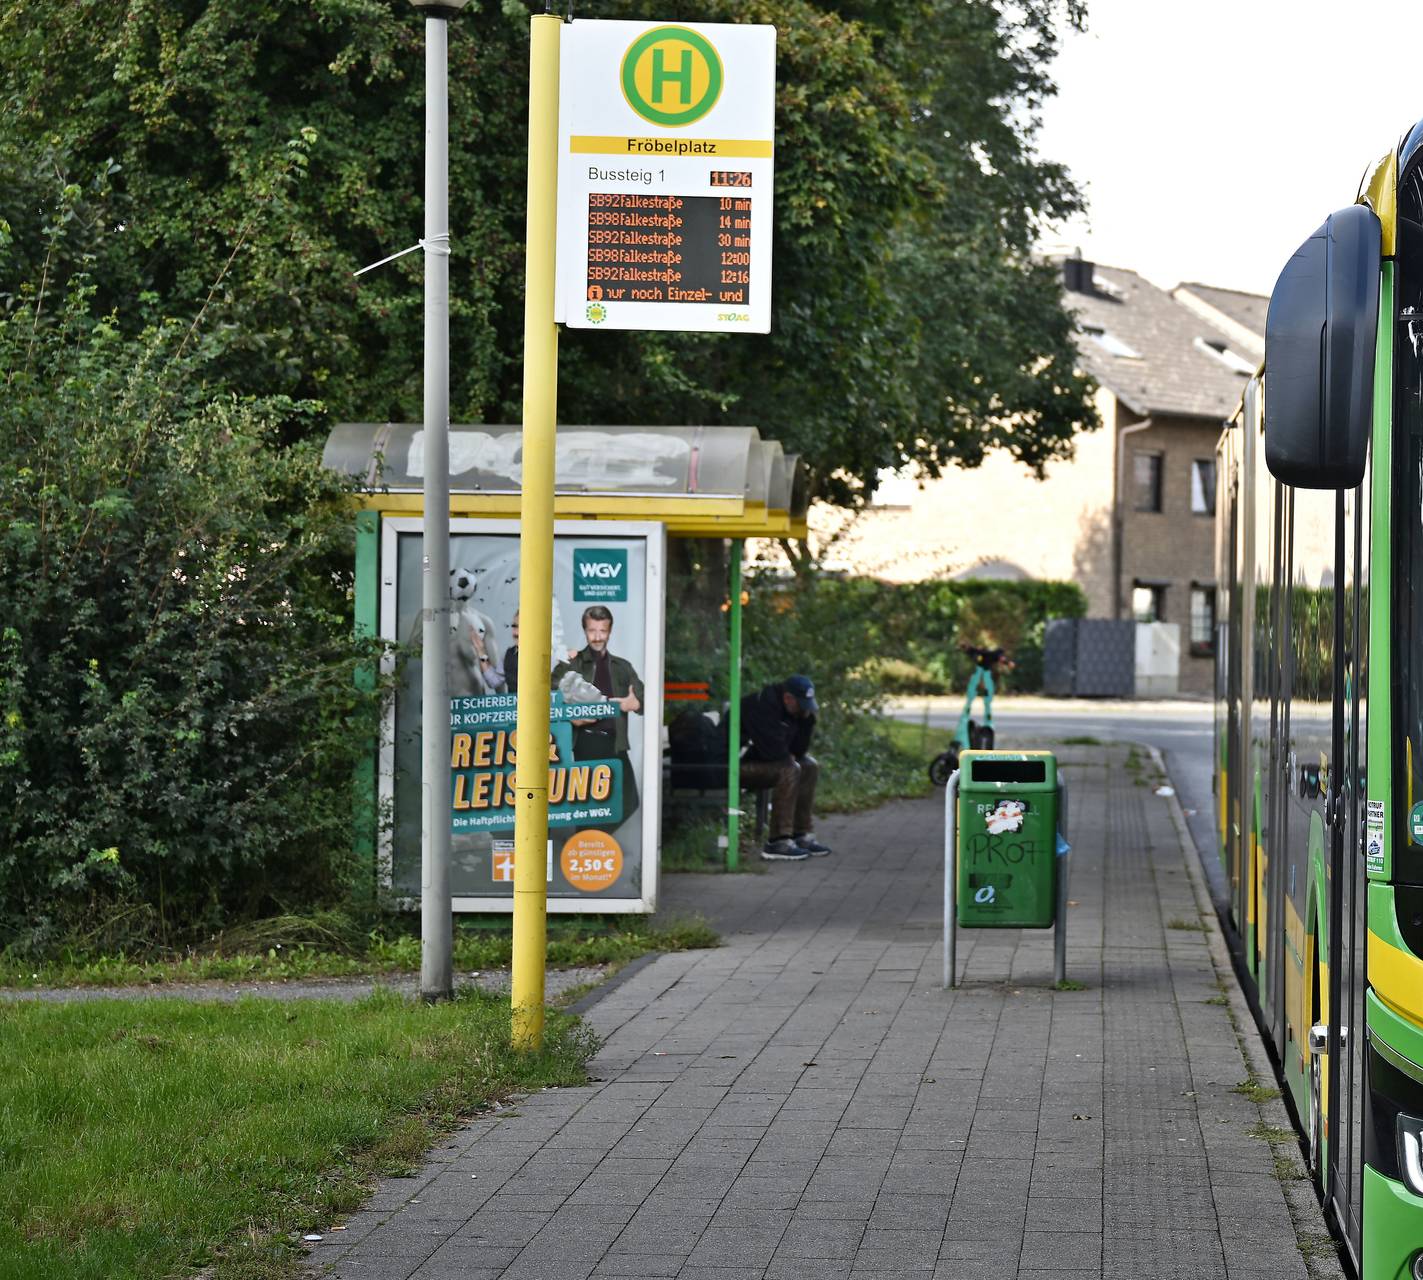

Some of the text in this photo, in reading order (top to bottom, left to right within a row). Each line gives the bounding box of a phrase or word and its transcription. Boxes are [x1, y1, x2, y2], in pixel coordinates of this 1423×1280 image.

[652, 48, 692, 104] H
[627, 138, 716, 156] Fröbelplatz
[589, 167, 665, 184] Bussteig 1
[712, 172, 751, 186] 11:26
[720, 198, 731, 210] 10
[720, 216, 731, 228] 14
[718, 233, 731, 247] 30
[721, 253, 750, 265] 12:00
[721, 271, 749, 284] 12:16
[632, 288, 663, 299] noch
[668, 288, 713, 301] Einzel-
[720, 290, 743, 302] und
[579, 562, 622, 578] WGV
[566, 704, 615, 718] SORGEN:
[451, 730, 517, 768] REIS
[453, 818, 468, 827] Die
[573, 810, 588, 819] der
[589, 808, 612, 817] WGV.
